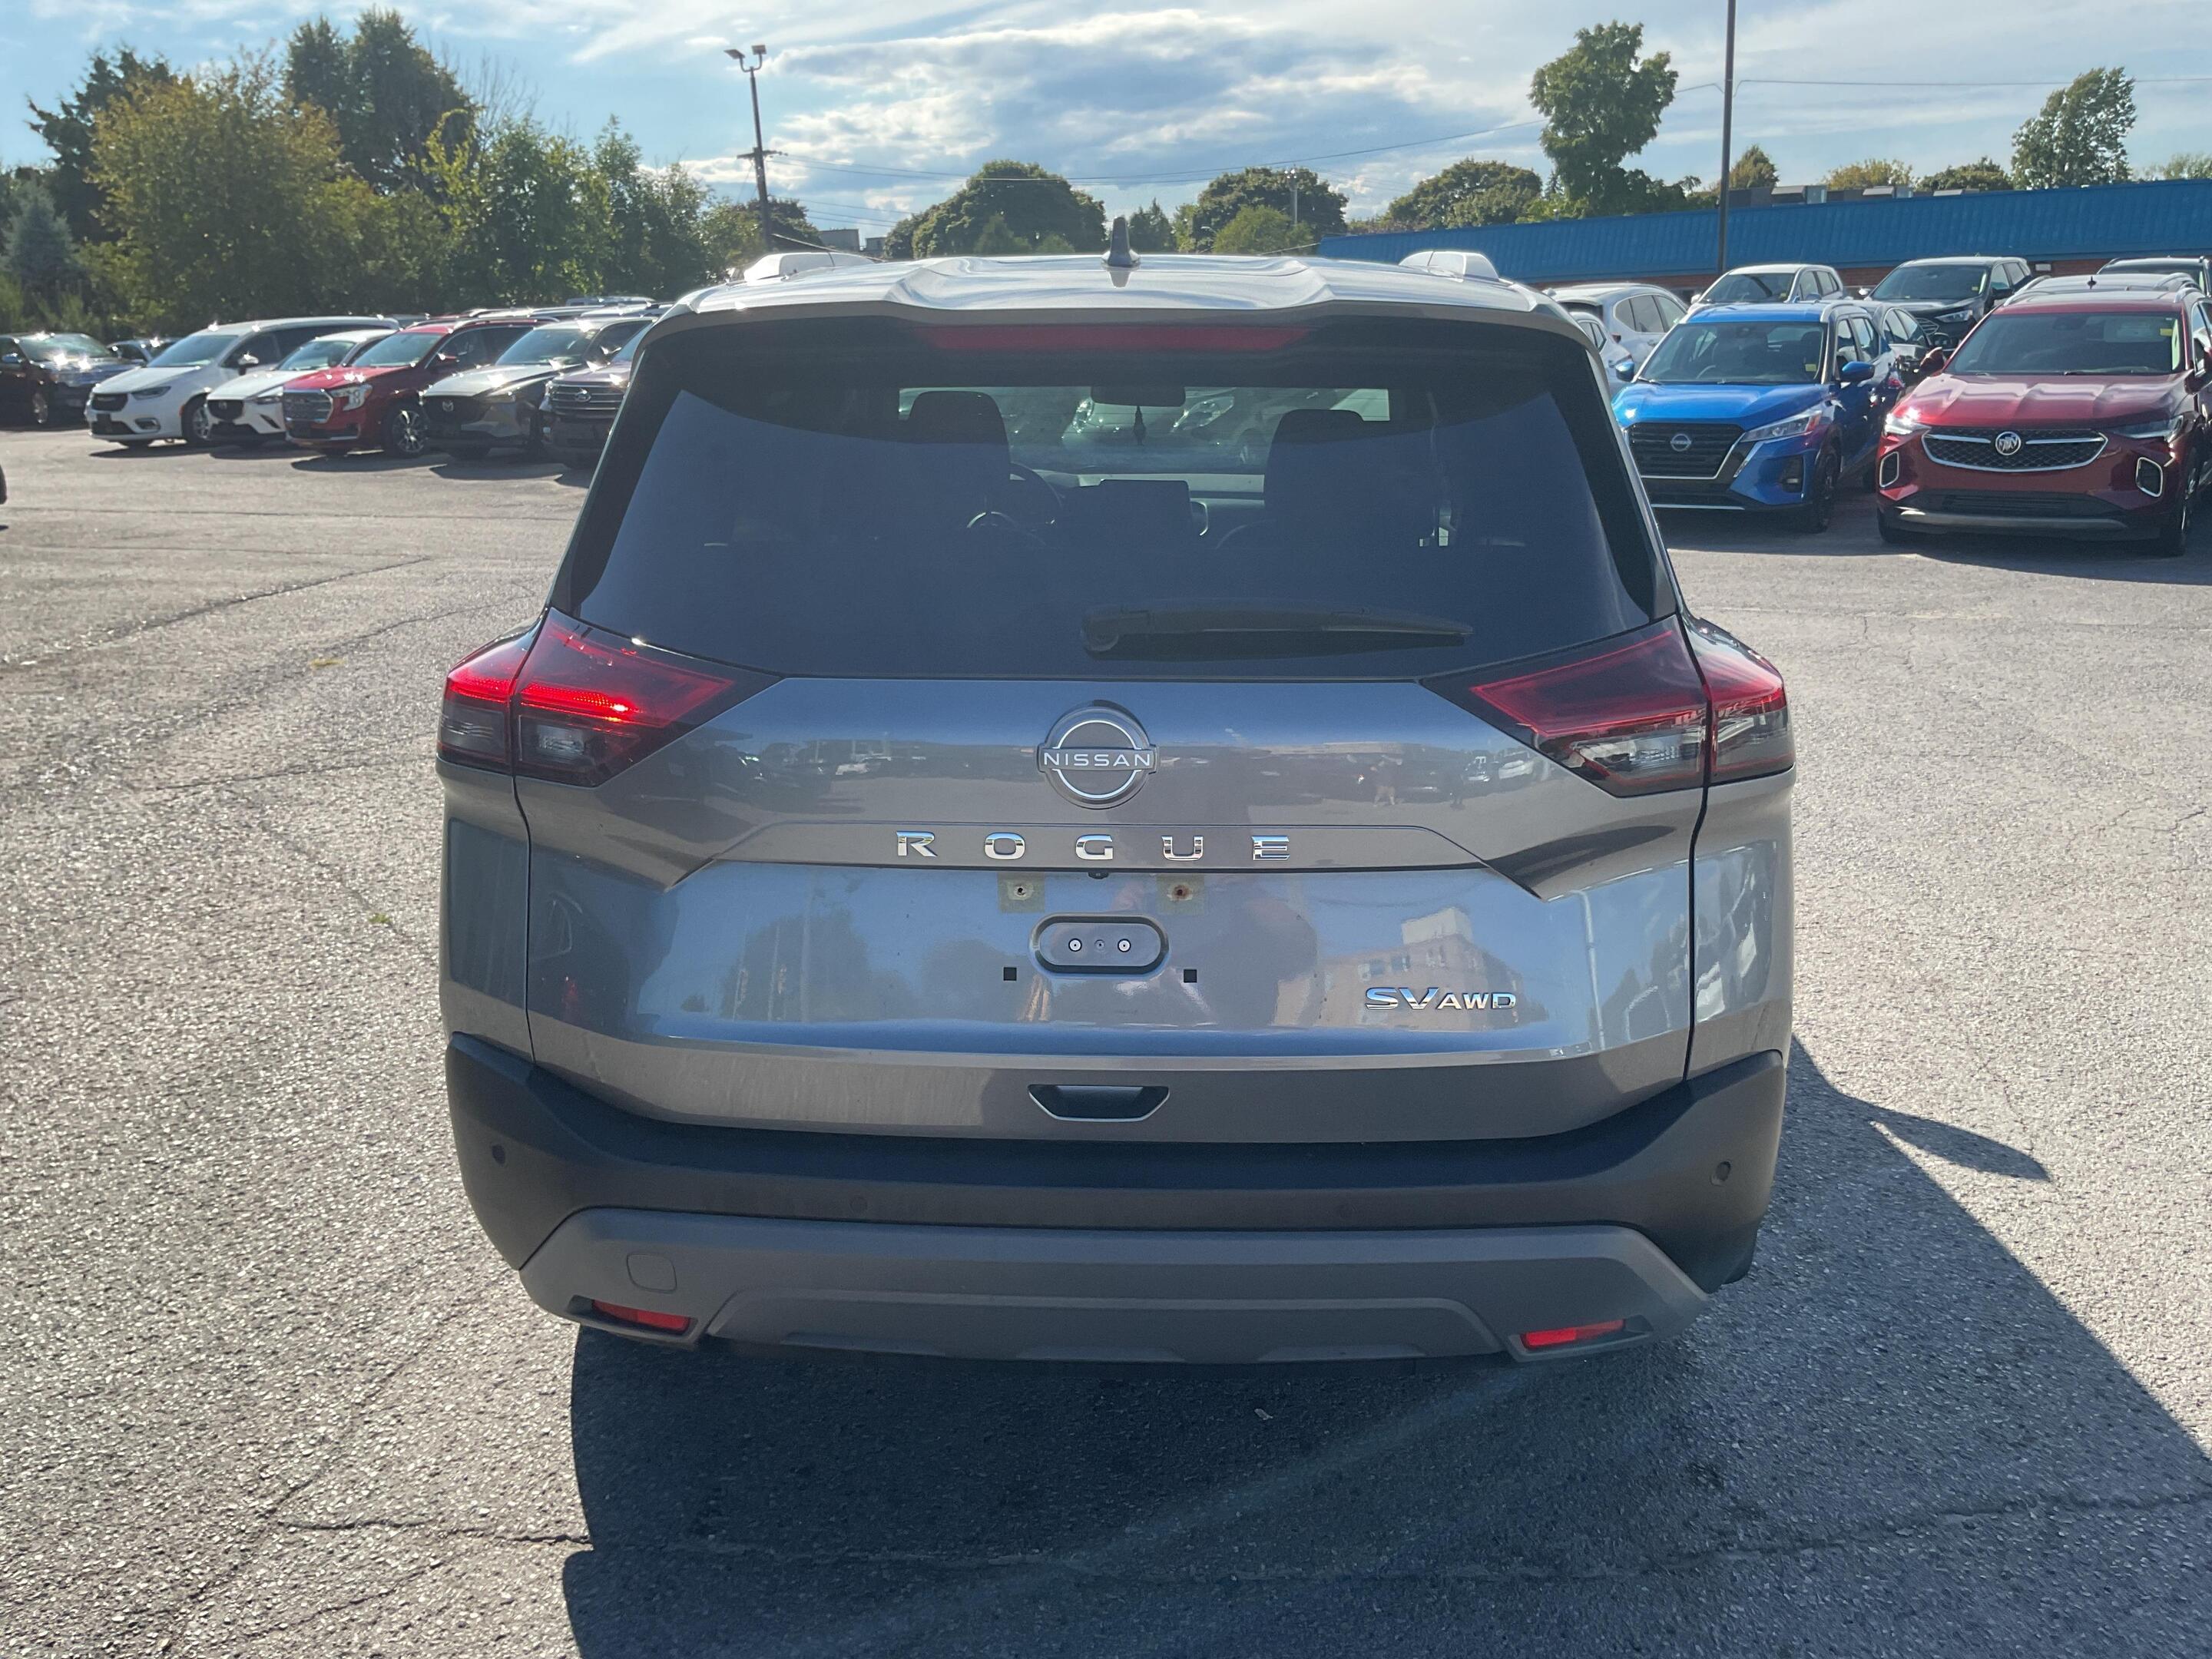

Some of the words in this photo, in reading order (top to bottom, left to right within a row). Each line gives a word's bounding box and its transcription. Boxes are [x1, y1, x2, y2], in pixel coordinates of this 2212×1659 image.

[1044, 753, 1150, 767] NISSAN
[896, 830, 1290, 861] ROGUE
[1366, 987, 1439, 1010] SV
[1435, 992, 1516, 1009] AWD
